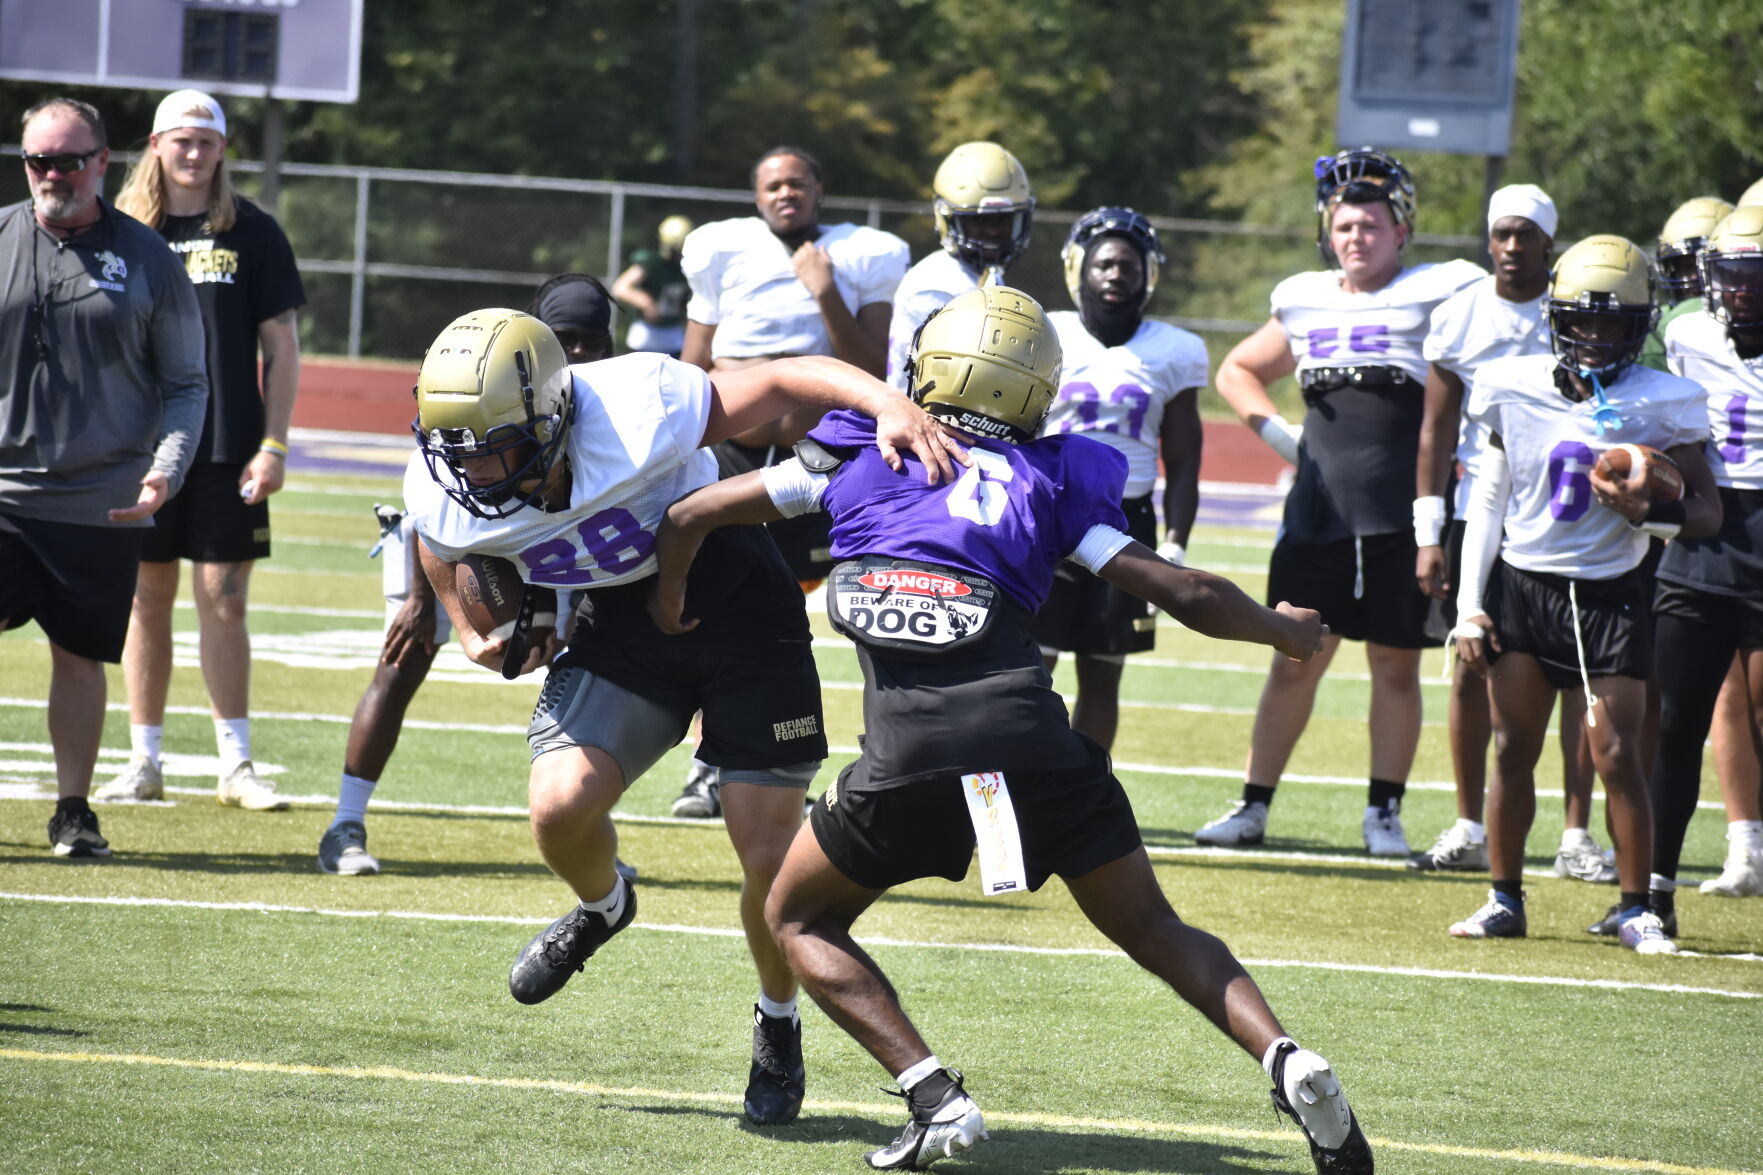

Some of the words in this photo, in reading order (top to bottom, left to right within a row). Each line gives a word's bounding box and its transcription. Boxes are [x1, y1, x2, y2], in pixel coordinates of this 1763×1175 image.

[959, 412, 1012, 436] schutt
[945, 446, 1015, 527] 6
[1548, 440, 1594, 522] 6
[481, 558, 505, 607] Wilson
[873, 574, 957, 595] DANGER
[849, 607, 938, 638] DOG
[773, 715, 816, 733] DEFIANCE
[775, 724, 819, 742] FOOTBALL
